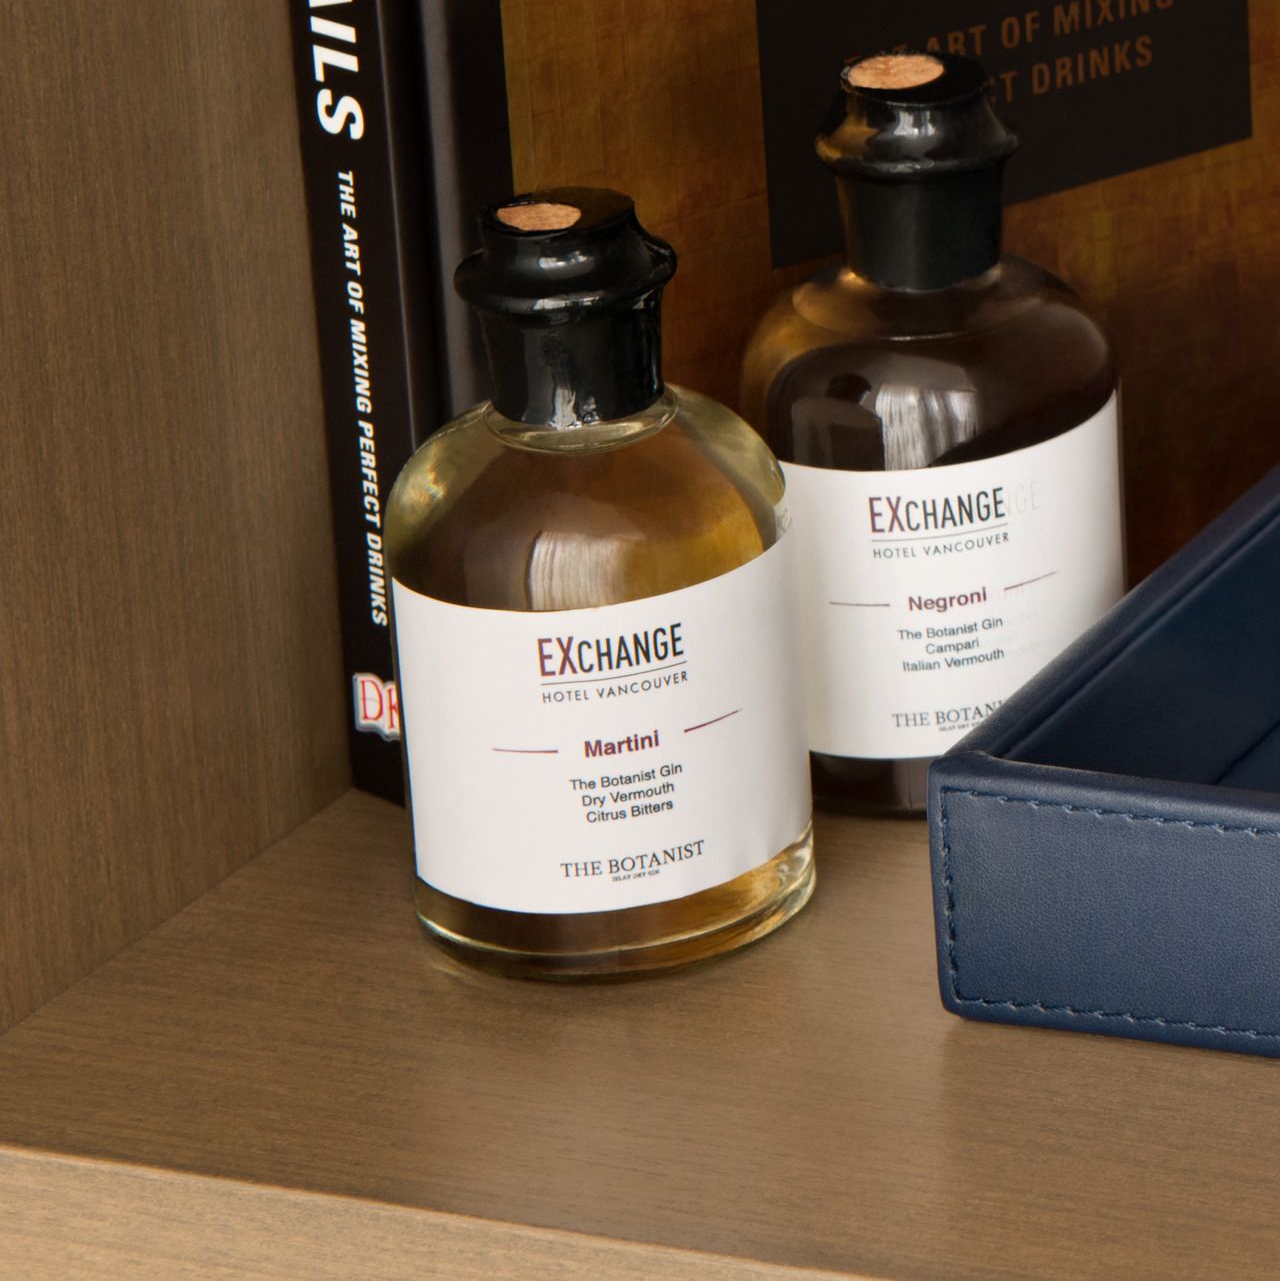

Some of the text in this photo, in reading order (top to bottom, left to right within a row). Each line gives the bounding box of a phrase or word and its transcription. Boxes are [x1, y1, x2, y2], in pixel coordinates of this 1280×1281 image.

[1000, 10, 1040, 49] OF
[1031, 34, 1153, 96] DRINKS
[338, 170, 388, 627] THE ART OF MIXING PERFECT DRINKS
[867, 486, 1006, 533] EXCHANGE
[872, 532, 1010, 560] HOTEL VANCOUVER
[908, 586, 987, 613] Negroni
[897, 616, 1004, 640] The Botanist Gin
[537, 622, 685, 677] EXCHANGE
[902, 648, 1005, 672] Italian Vermouth
[925, 638, 979, 655] Campari
[542, 670, 688, 704] HOTEL VANCOUVER
[891, 711, 931, 728] THE
[935, 700, 1003, 725] BOTAN
[584, 729, 660, 758] Martini
[570, 763, 683, 791] The Botanist Gin
[581, 781, 675, 808] Dry Vermouth
[586, 799, 674, 823] Citrus Bitters
[560, 839, 705, 878] THE BOTANIST
